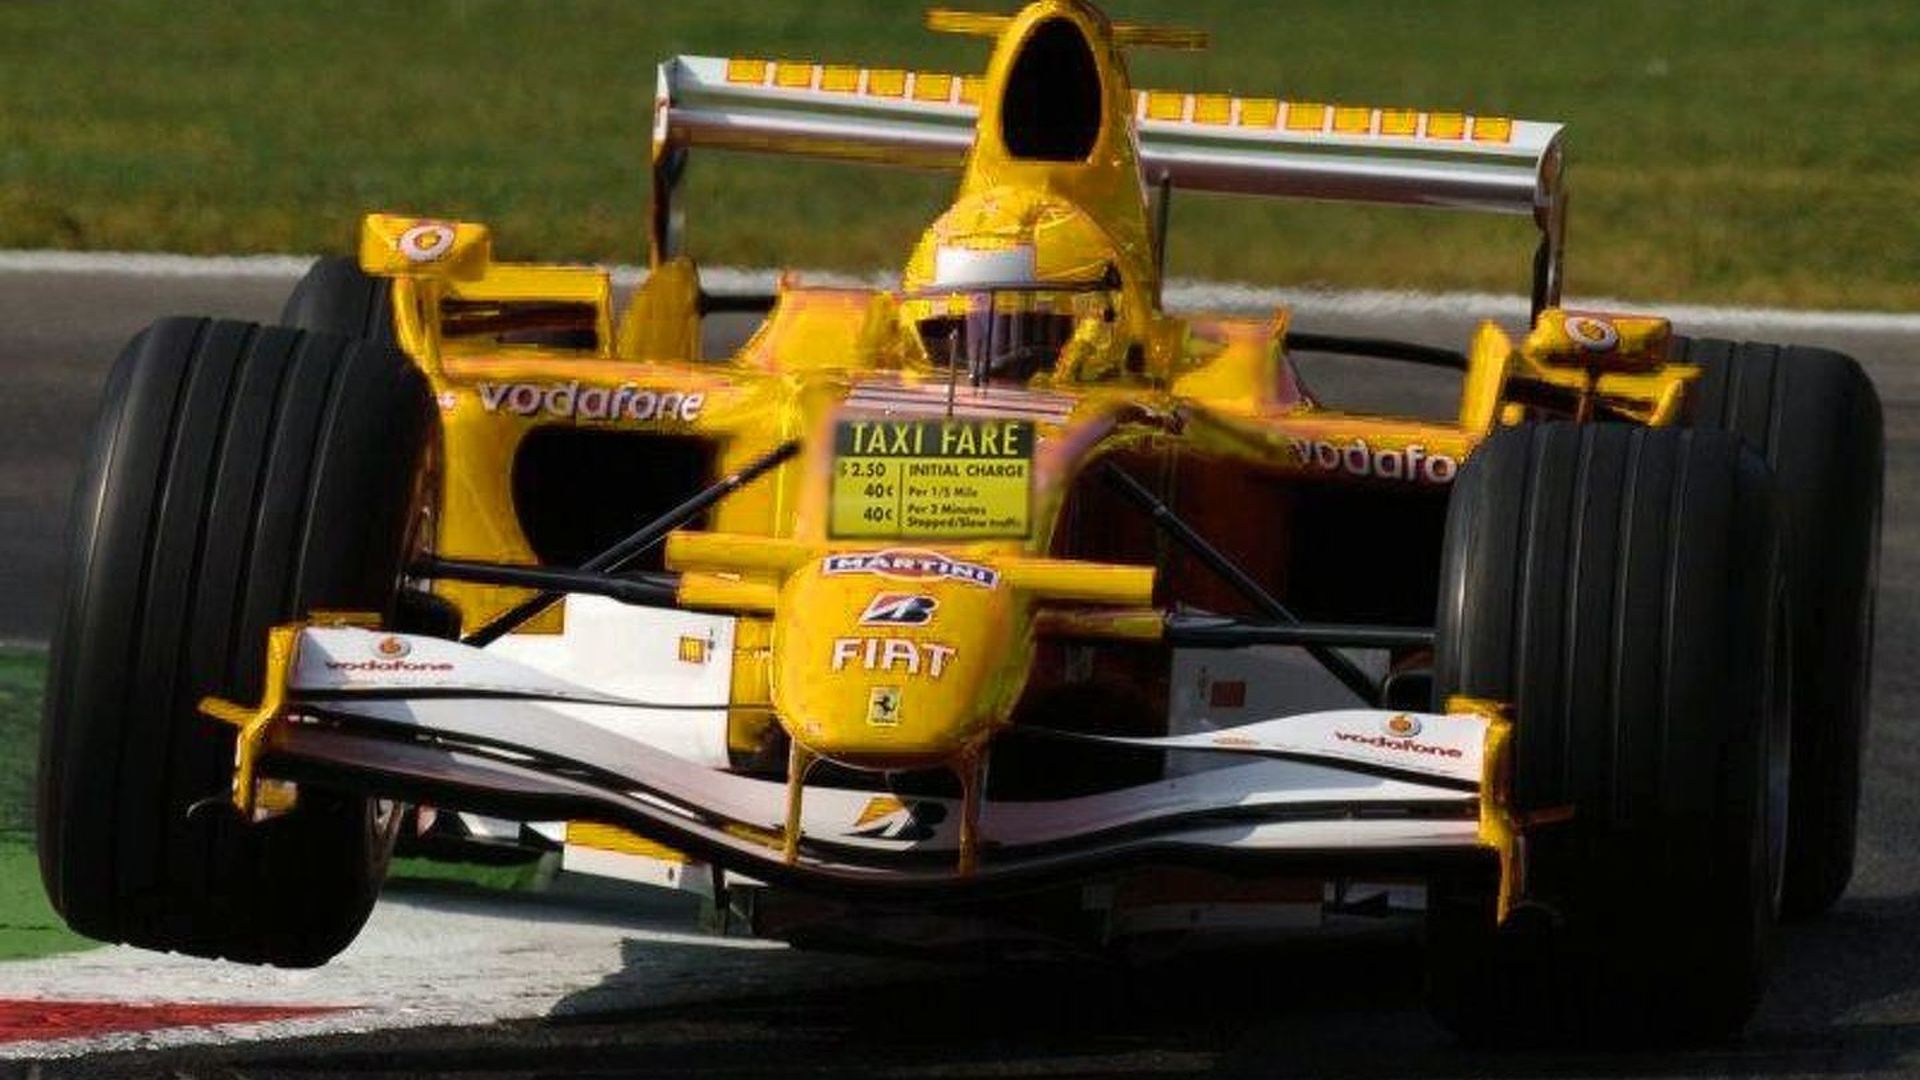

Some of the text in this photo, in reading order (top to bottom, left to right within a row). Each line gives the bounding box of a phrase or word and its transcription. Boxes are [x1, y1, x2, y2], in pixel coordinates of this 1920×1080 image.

[479, 380, 705, 421] vodafone
[851, 421, 1020, 455] TAXI FARE
[909, 465, 1024, 478] INITIAL CHARGE
[909, 486, 928, 498] Per
[908, 504, 928, 516] Per
[837, 556, 989, 582] MARTINI
[325, 660, 455, 672] vodafone
[832, 638, 956, 678] FIAT
[1335, 732, 1463, 758] vodafone
